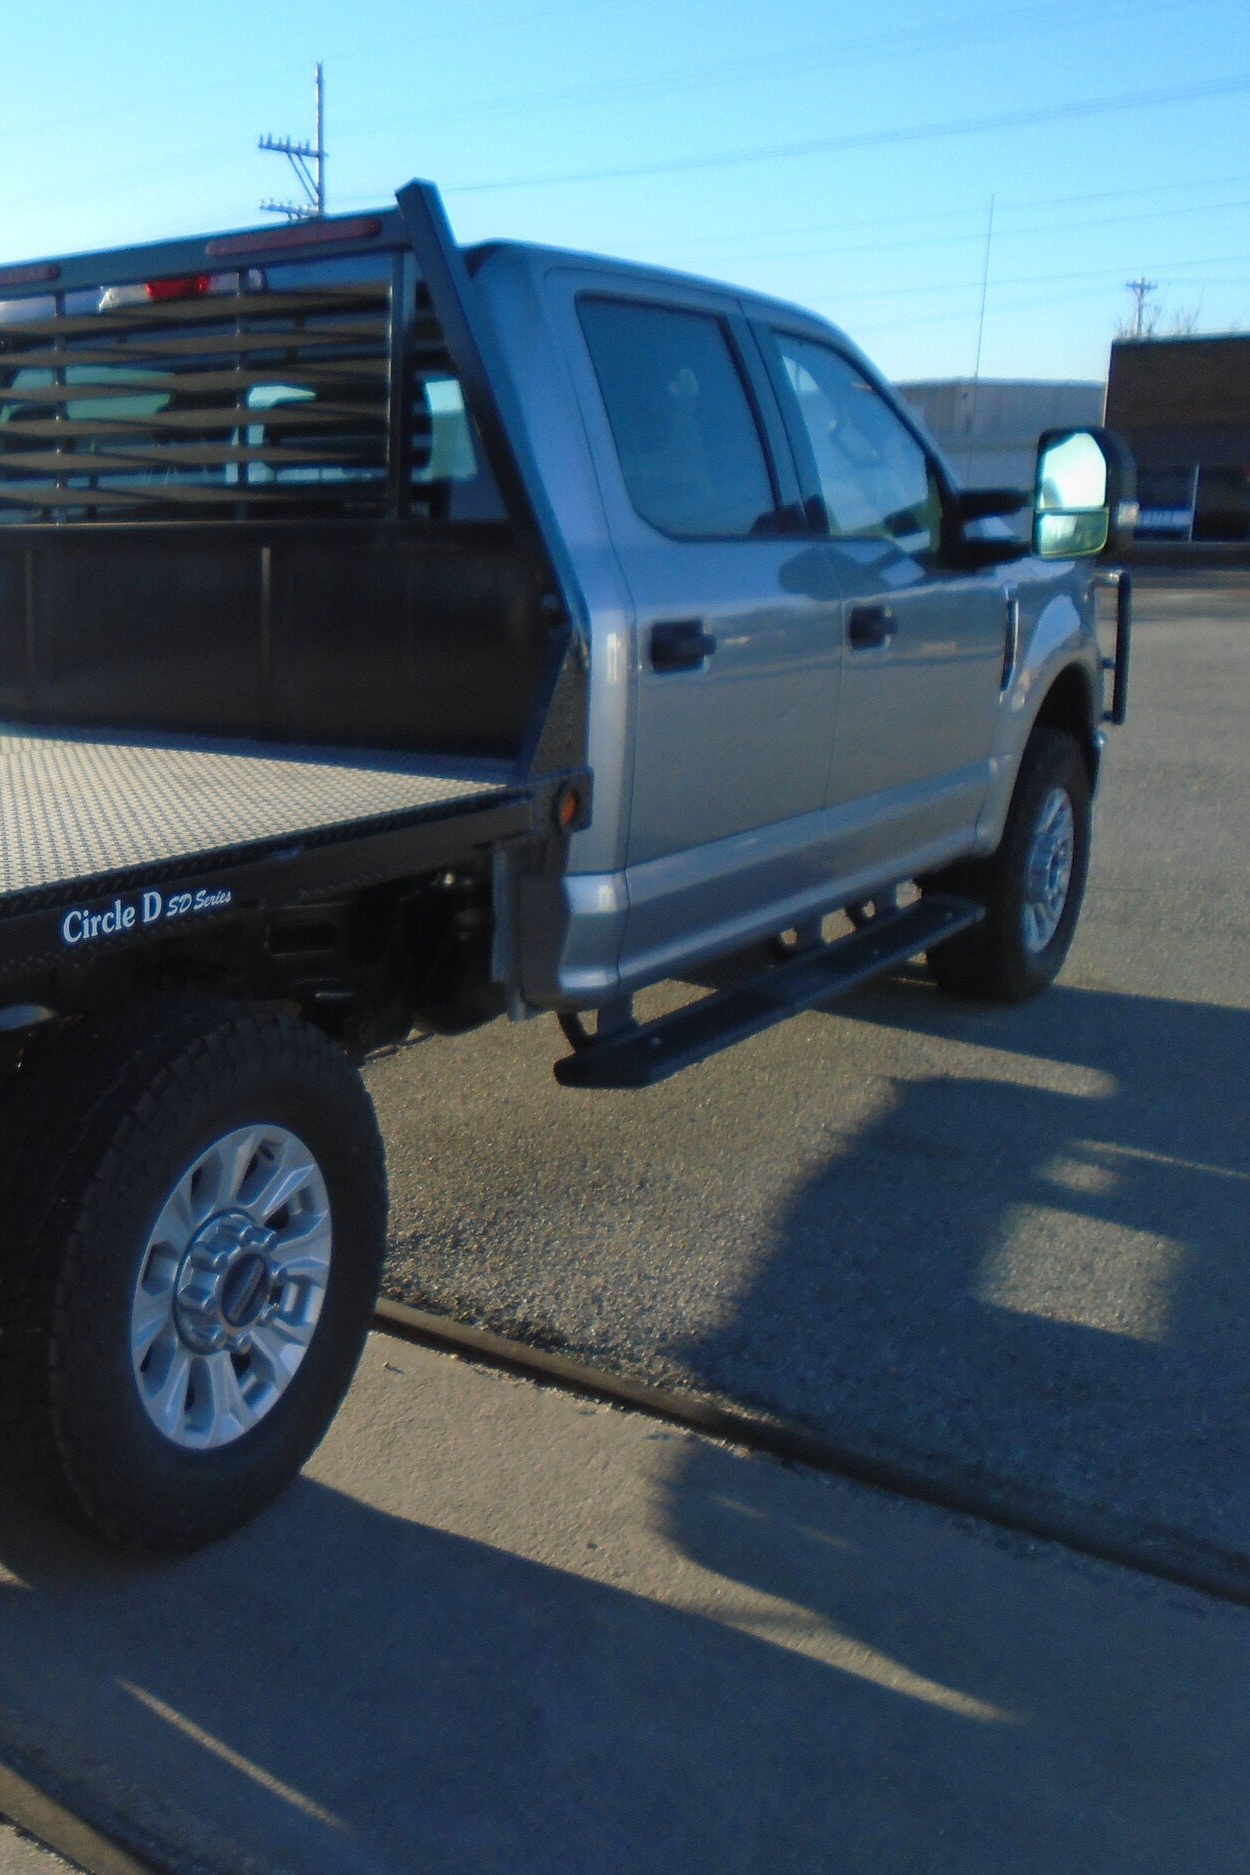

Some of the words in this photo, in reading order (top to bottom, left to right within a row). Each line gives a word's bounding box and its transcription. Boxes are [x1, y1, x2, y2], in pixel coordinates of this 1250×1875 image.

[63, 899, 136, 943] Circle
[143, 891, 162, 923] D
[166, 893, 192, 917] SD
[193, 889, 232, 910] Series
